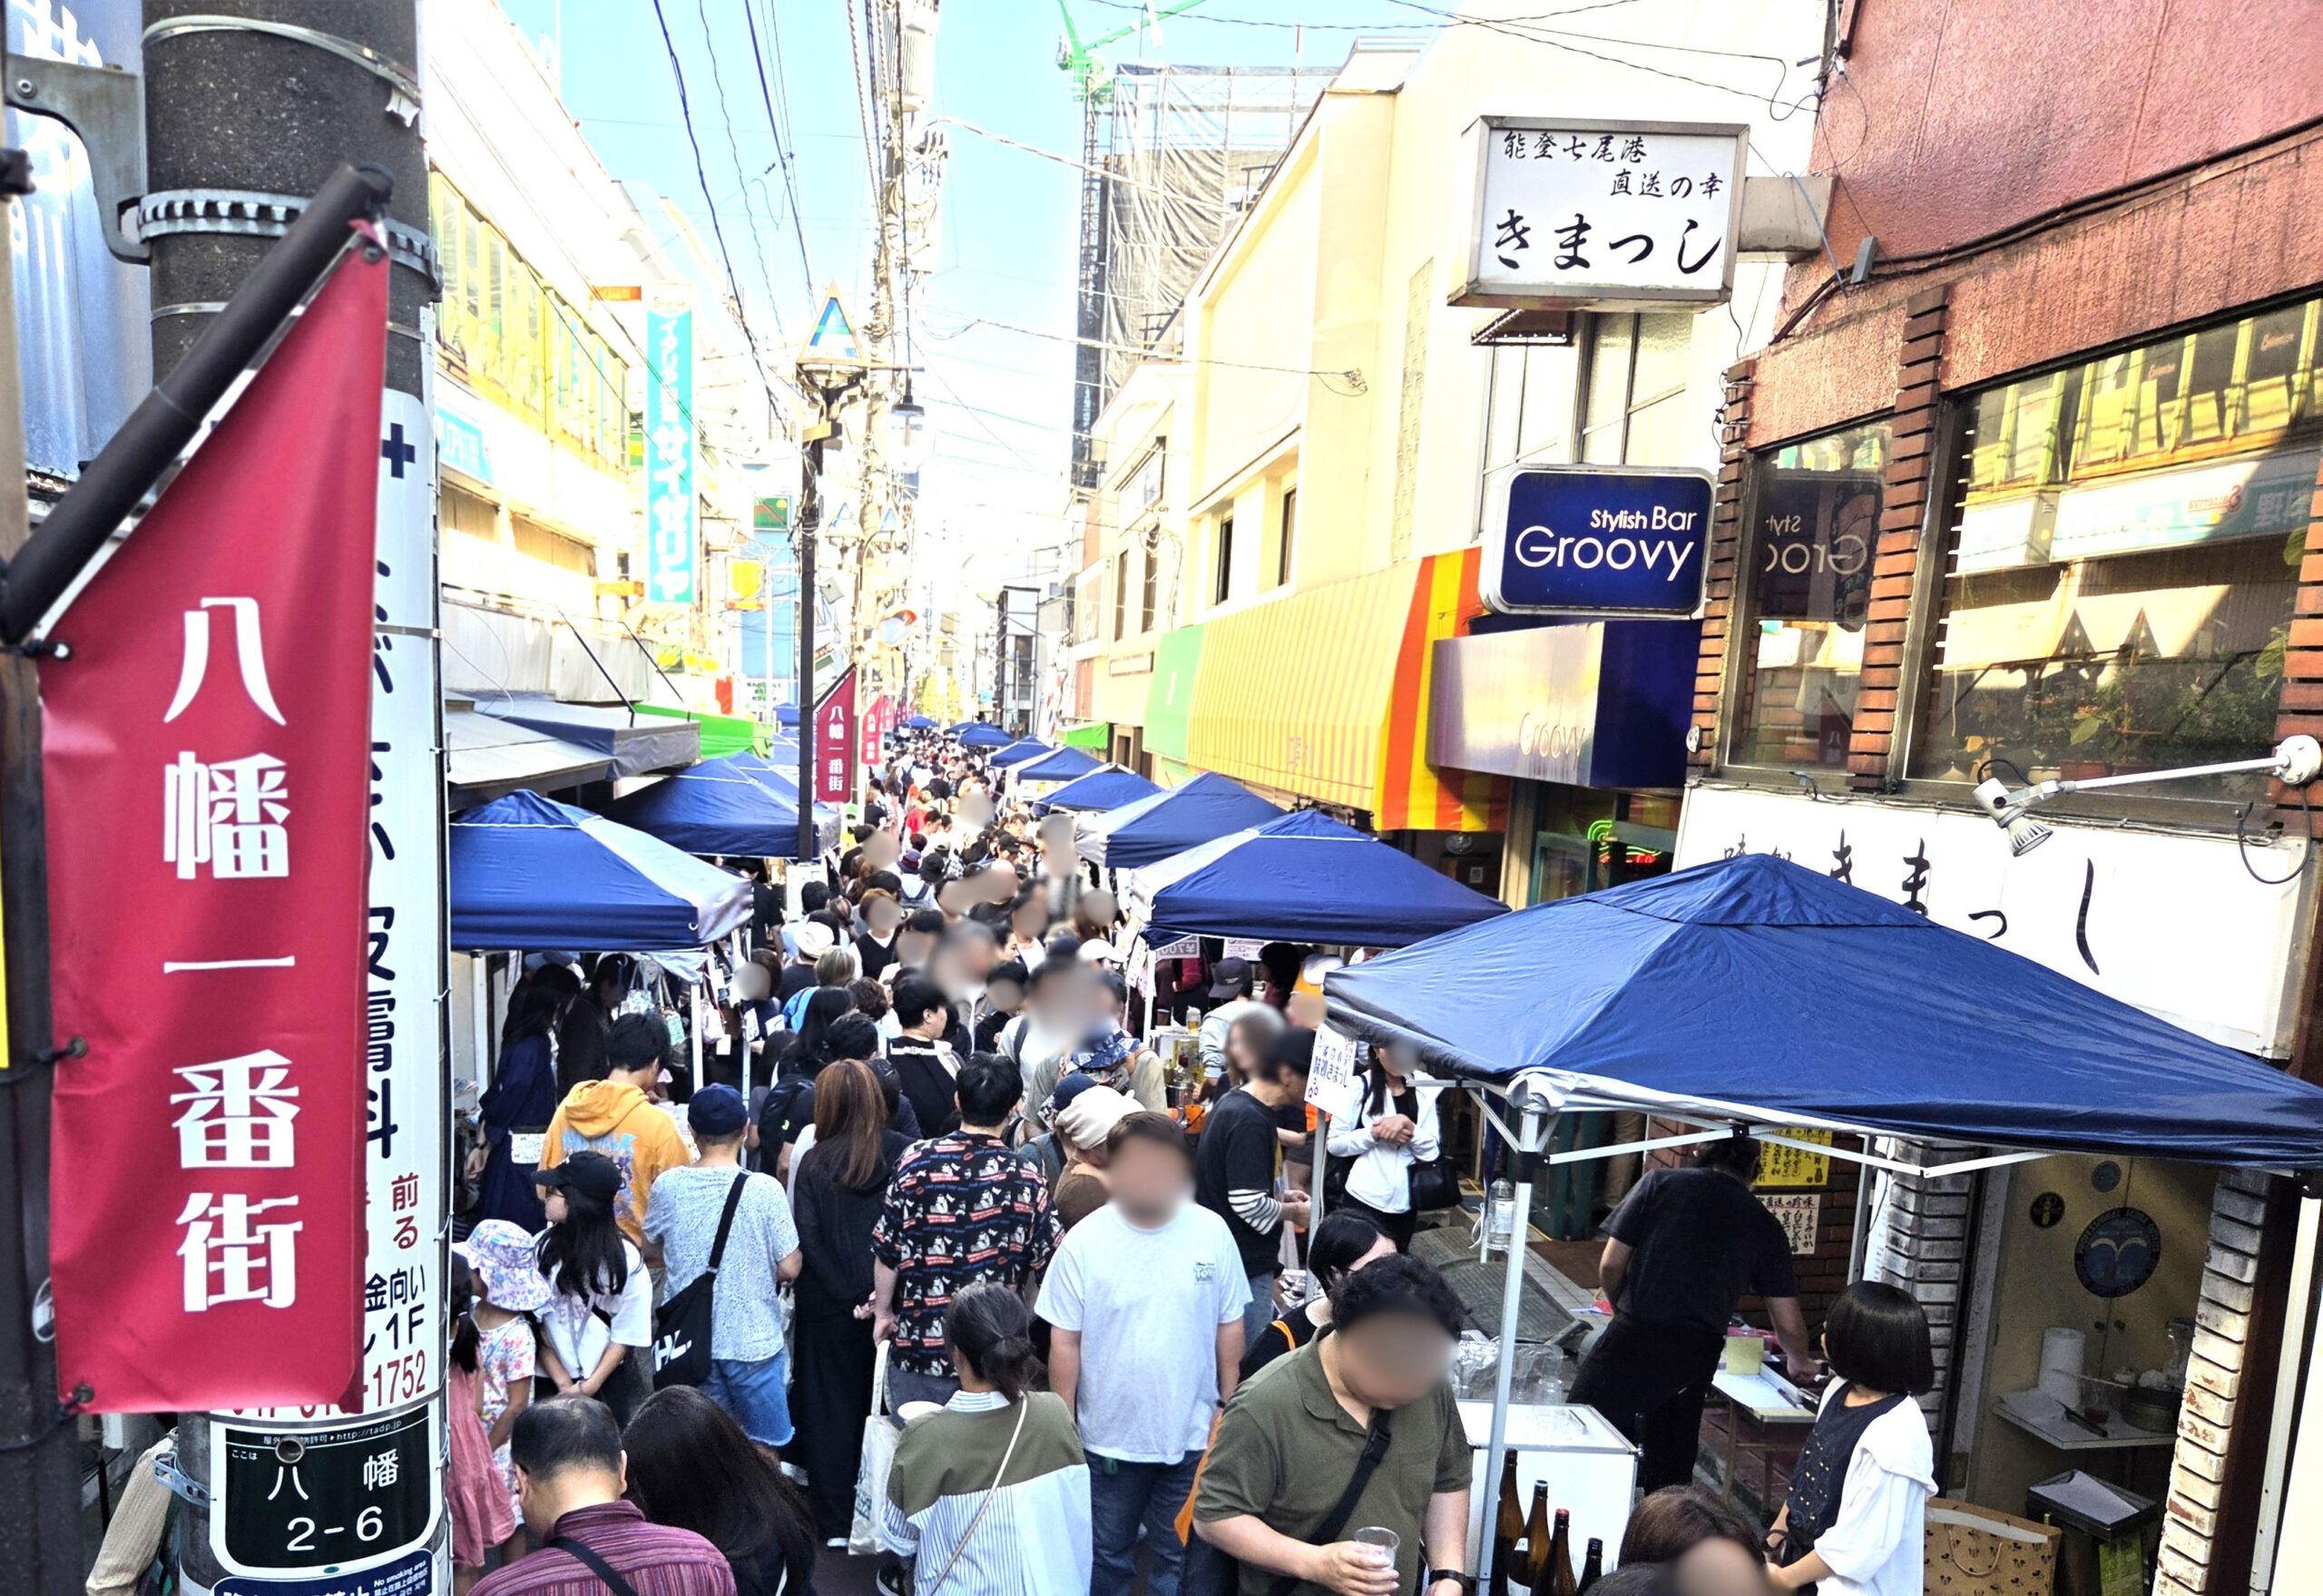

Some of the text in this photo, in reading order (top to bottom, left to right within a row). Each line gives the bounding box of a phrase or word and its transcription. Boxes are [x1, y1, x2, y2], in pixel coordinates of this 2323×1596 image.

[1504, 131, 1648, 164] 能登七尾港
[1609, 169, 1724, 200] 直送の幸
[1495, 210, 1722, 275] きまつし
[652, 424, 690, 601] サイゼリヤ
[1590, 505, 1697, 533] Stylish Bar
[1514, 525, 1694, 581] Groovy
[828, 706, 844, 791] 八幡一番街
[163, 596, 303, 1313] 八幡一番街
[263, 1419, 402, 1446] 屋外物許可 http://tadp.jp
[287, 1505, 383, 1552] 2-6
[374, 1579, 385, 1587] No
